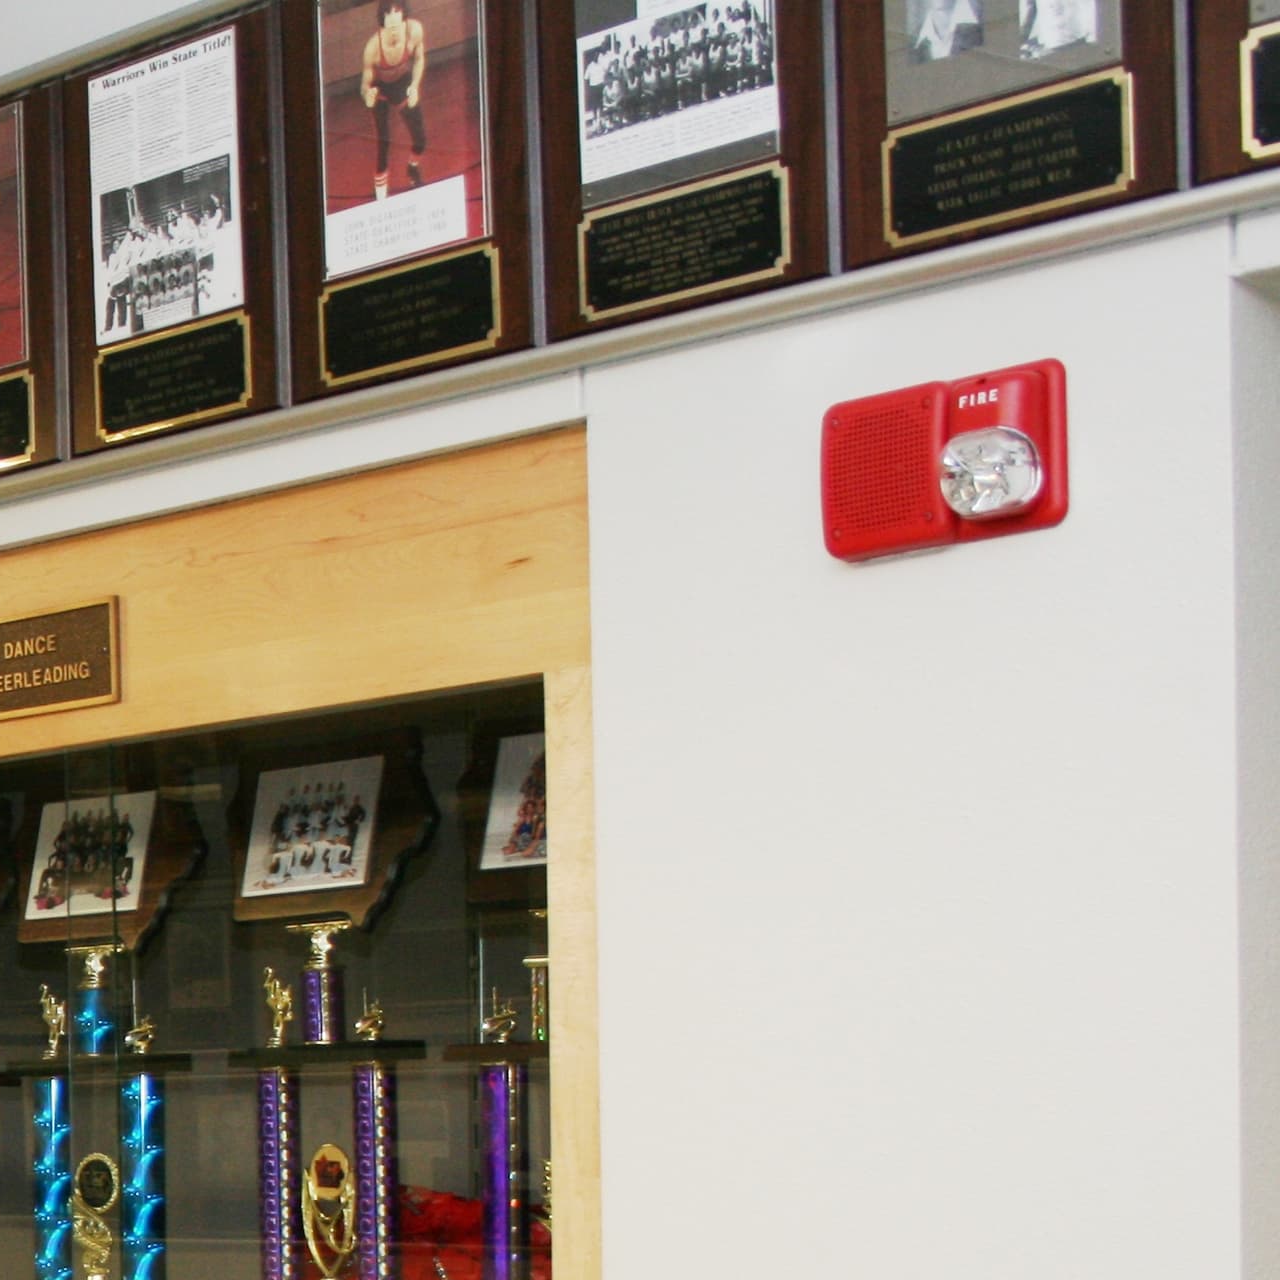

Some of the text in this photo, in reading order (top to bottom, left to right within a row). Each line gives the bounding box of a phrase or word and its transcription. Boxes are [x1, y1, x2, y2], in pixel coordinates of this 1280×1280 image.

[101, 67, 146, 91] Warriors
[148, 59, 169, 74] Win
[171, 49, 199, 66] State
[958, 387, 999, 409] FIRE
[3, 634, 57, 660] DANCE
